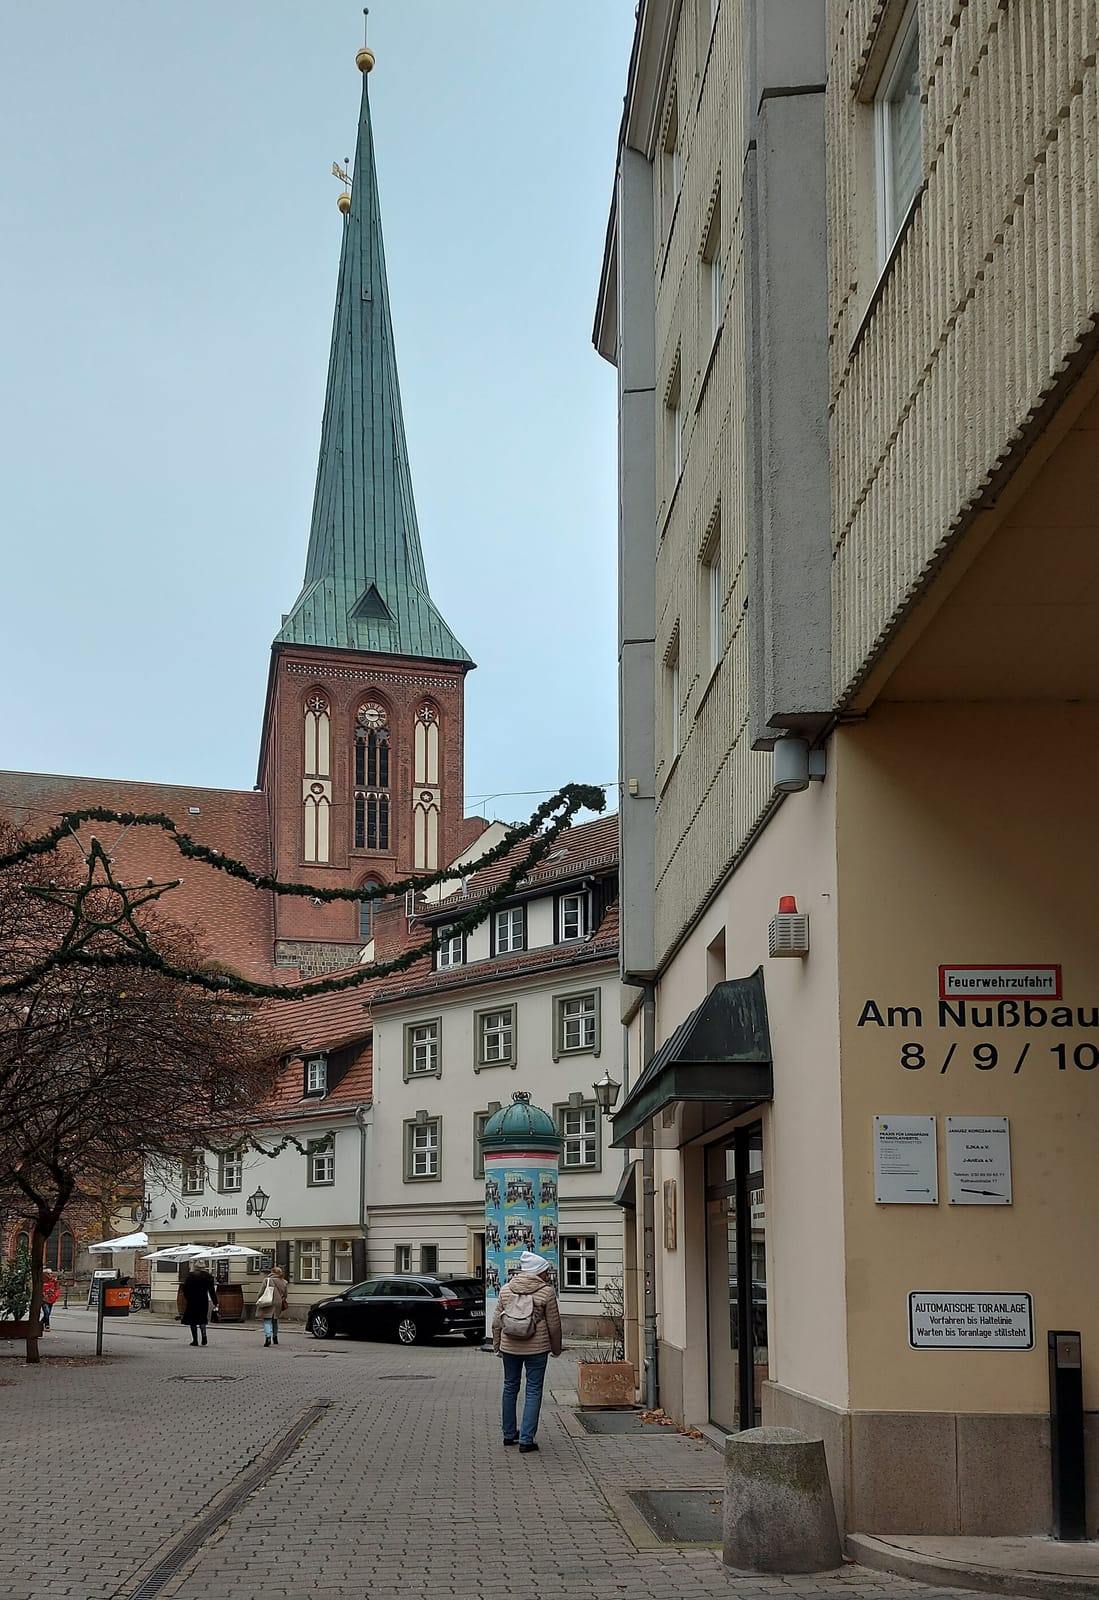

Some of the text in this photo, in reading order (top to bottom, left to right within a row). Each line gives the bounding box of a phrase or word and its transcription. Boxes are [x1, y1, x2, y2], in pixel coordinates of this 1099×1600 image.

[948, 976, 1053, 988] Feuerwehrzufahrt
[857, 1000, 1099, 1027] Am Nußbau
[901, 1043, 1099, 1074] 8 / 9 / 10
[184, 1207, 200, 1219] Zum
[915, 1303, 1026, 1313] AUTOMATISCHE TORANLAGE
[930, 1316, 1013, 1325] Vorfahren bis Haltelinie
[917, 1328, 1026, 1339] Warten bis Toranlage stillsteht
